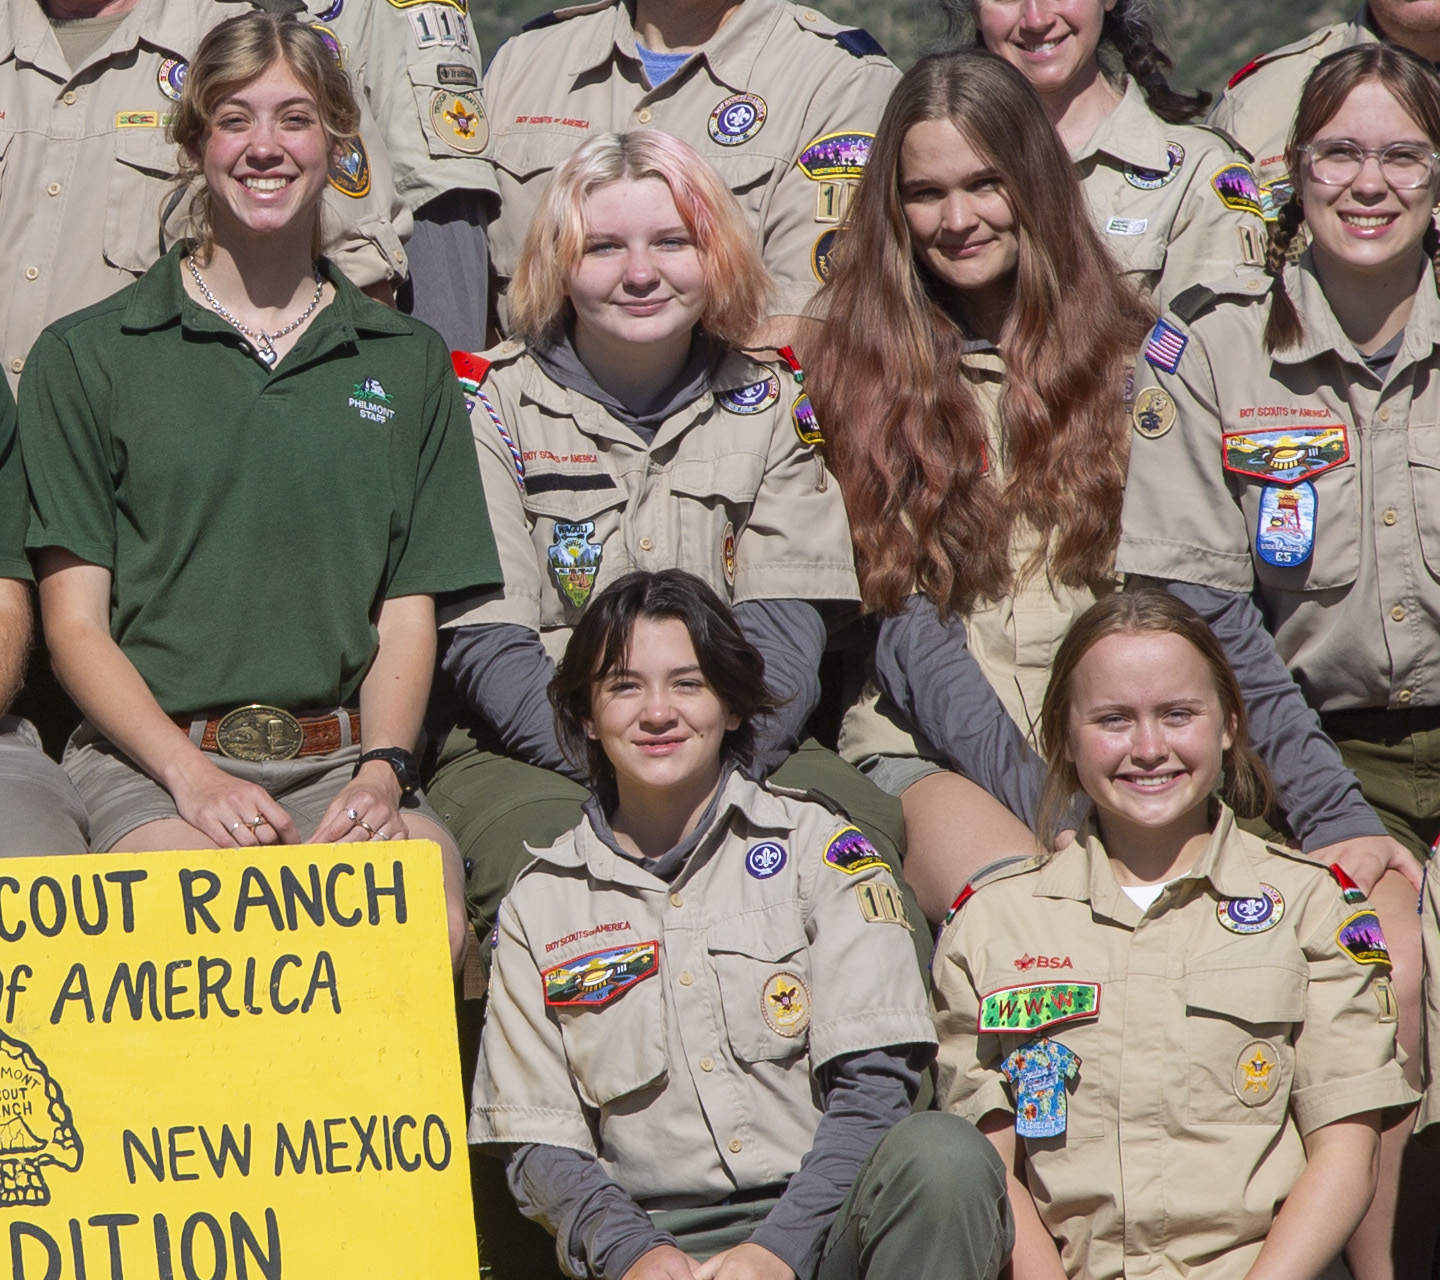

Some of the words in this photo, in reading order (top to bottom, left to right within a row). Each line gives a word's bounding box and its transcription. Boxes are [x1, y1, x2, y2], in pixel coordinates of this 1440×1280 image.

[348, 397, 395, 419] PHILMONT
[359, 408, 387, 424] STAFF
[1239, 408, 1255, 418] BOY
[1257, 406, 1289, 418] SCOUTS
[1299, 407, 1331, 419] AMERICA
[570, 453, 599, 464] AMERICA
[558, 524, 588, 534] WAGULI
[179, 861, 407, 934] RANCH
[545, 939, 561, 953] BOY
[560, 929, 590, 947] SCOUTS
[595, 920, 631, 934] AMERICA
[1036, 955, 1074, 969] BSA
[50, 951, 341, 1024] AMERICA
[998, 999, 1019, 1019] W
[1024, 996, 1045, 1017] W
[1051, 990, 1073, 1011] W
[123, 1124, 251, 1184] NEW
[275, 1115, 451, 1176] MEXICO
